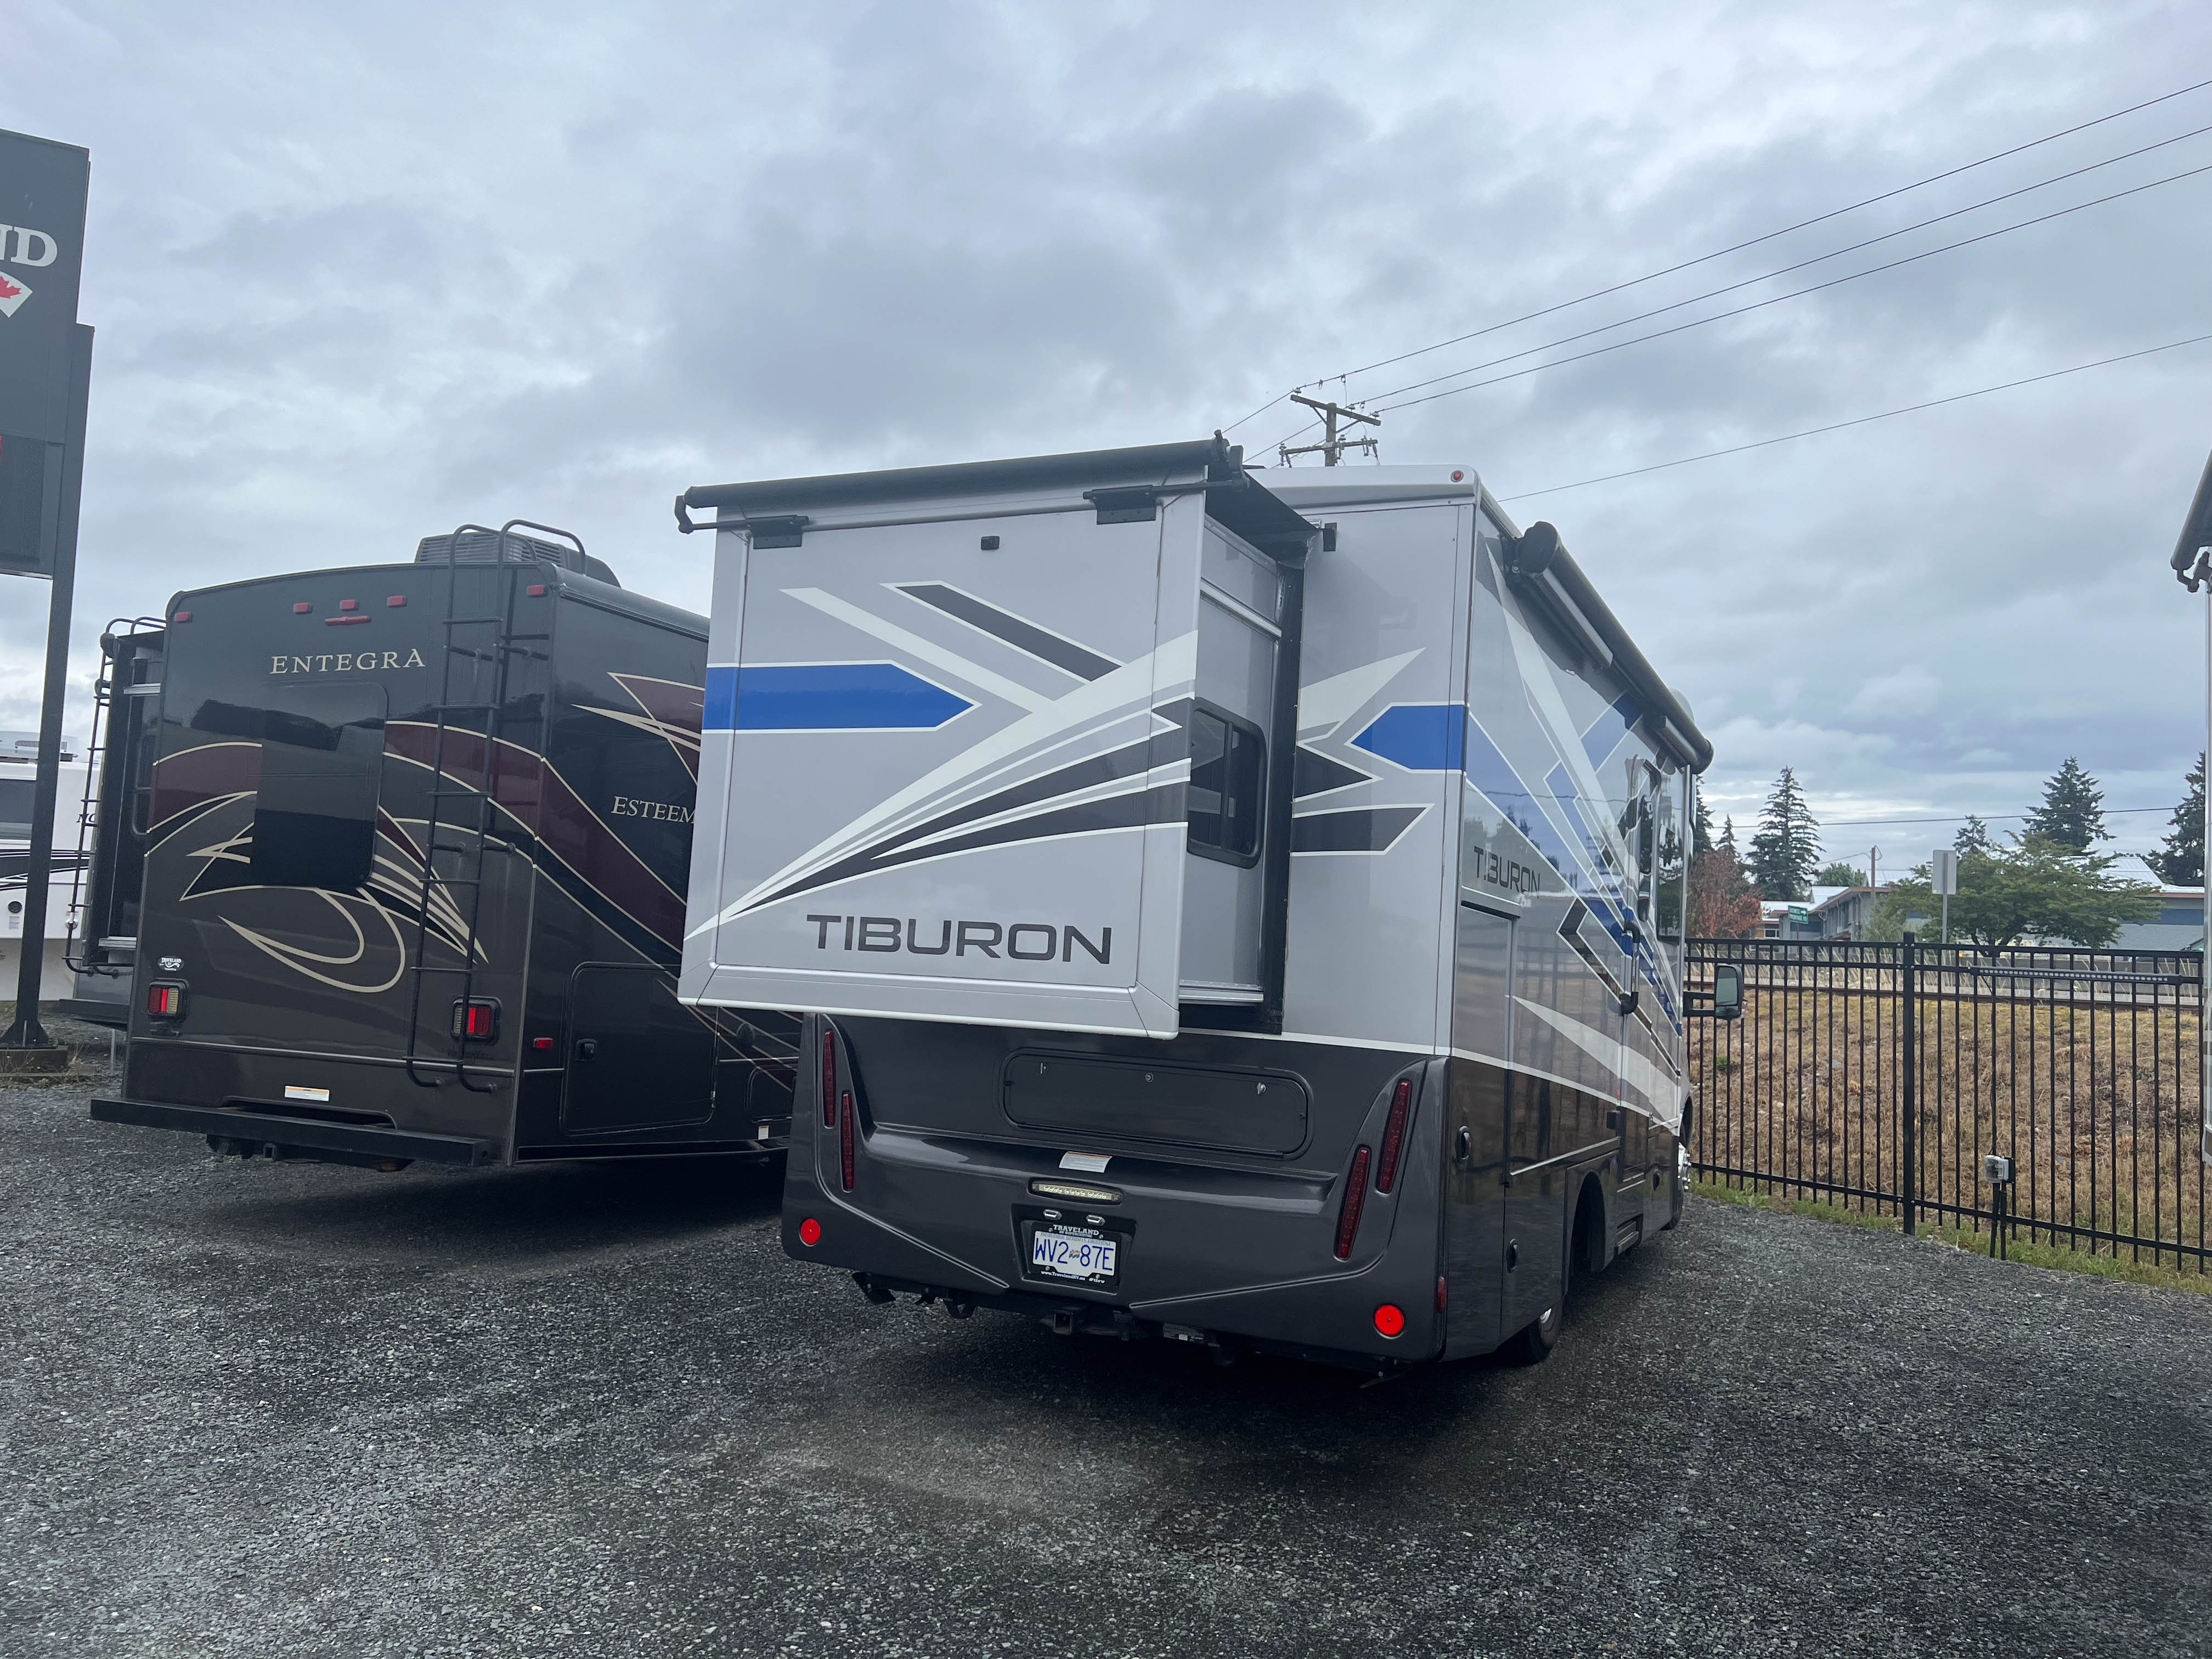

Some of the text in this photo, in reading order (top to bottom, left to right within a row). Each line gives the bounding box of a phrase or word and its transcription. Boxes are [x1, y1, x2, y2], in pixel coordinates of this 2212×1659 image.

[0, 224, 58, 267] D
[269, 648, 426, 674] ENTEGRA
[611, 796, 695, 824] ESTEEM
[1474, 846, 1541, 899] TIBURON
[806, 915, 1112, 964] TIBURON
[1053, 1224, 1099, 1235] TRAVELAND
[1085, 1238, 1110, 1246] Columbia
[1035, 1238, 1114, 1271] WV2 87E
